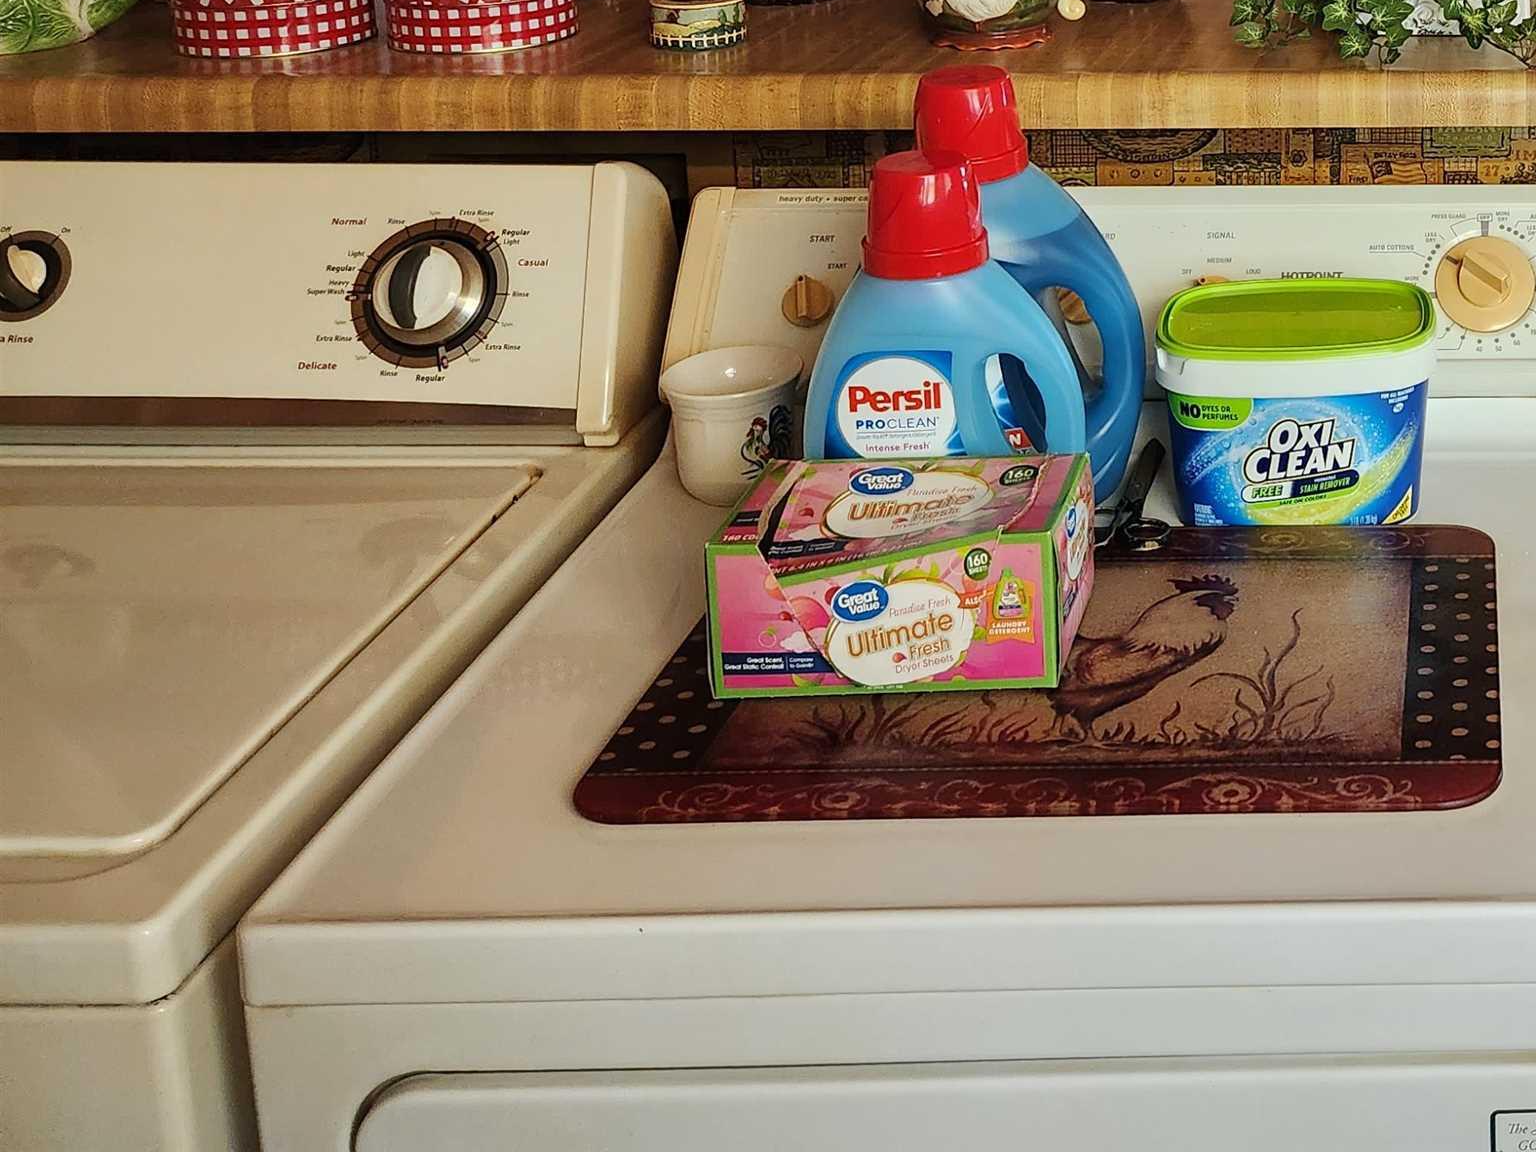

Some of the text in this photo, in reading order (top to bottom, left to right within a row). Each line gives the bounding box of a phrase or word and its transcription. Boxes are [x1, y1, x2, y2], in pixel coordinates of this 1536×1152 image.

[778, 195, 803, 204] heavy
[804, 195, 823, 204] duty
[833, 196, 857, 204] super
[331, 217, 368, 226] Normal
[501, 228, 531, 238] Regular
[809, 234, 836, 244] START
[1206, 231, 1237, 240] SIGNAL
[325, 264, 357, 274] Regular
[517, 258, 550, 268] Casual
[827, 262, 848, 270] START
[8, 334, 34, 344] Rinse
[315, 334, 353, 343] Extra Rinse
[485, 343, 521, 351] Extra Rinse
[297, 361, 338, 370] Delicate
[415, 374, 445, 384] Regular
[848, 380, 942, 413] Persil
[1180, 400, 1202, 420] NO
[1202, 405, 1217, 413] DYES
[856, 416, 937, 430] PROCLEAN
[1202, 413, 1239, 421] PERFUMES
[1269, 419, 1335, 454] OXI
[865, 441, 930, 453] Intense Fresh
[1245, 439, 1354, 483] CLEAN
[858, 472, 905, 485] Great
[1006, 468, 1035, 479] 160
[867, 479, 902, 490] Value
[1319, 477, 1351, 490] REMOVER
[1251, 485, 1283, 498] FREE
[848, 494, 976, 521] Ultimate
[967, 552, 988, 568] 160
[838, 588, 879, 608] Great
[848, 601, 880, 615] Value
[889, 595, 951, 617] Paradise Fresh
[847, 612, 953, 657] Ultimate
[909, 638, 950, 659] Fresh
[896, 654, 954, 674] Dryer Sheets
[1507, 1122, 1529, 1135] The
